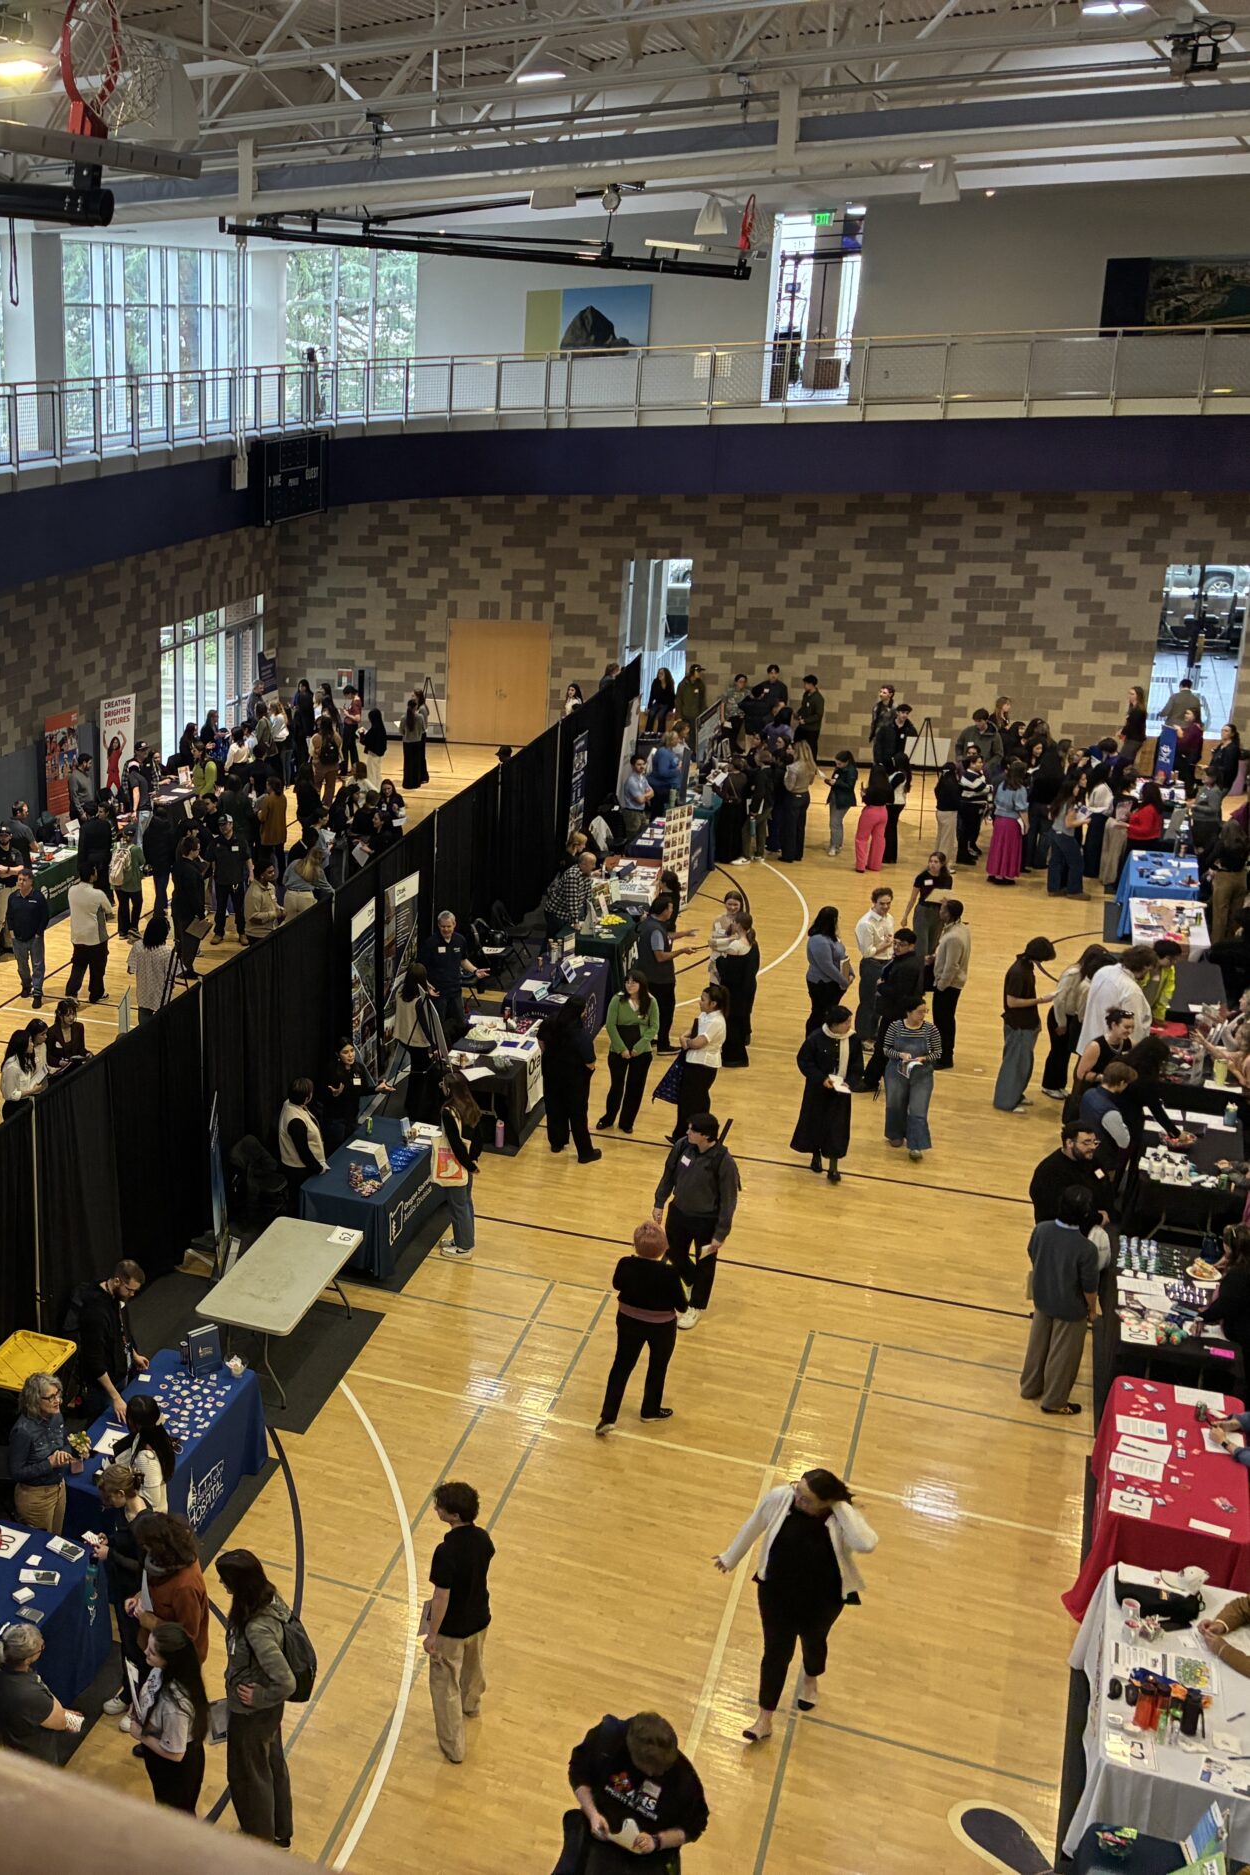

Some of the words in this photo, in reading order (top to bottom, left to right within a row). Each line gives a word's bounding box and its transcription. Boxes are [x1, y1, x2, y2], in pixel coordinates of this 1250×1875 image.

[104, 697, 131, 710] CREATING
[104, 706, 131, 719] BRIGHTER
[105, 715, 130, 727] FUTURES
[189, 1482, 224, 1526] HOSPITAL
[1118, 1495, 1142, 1512] 51
